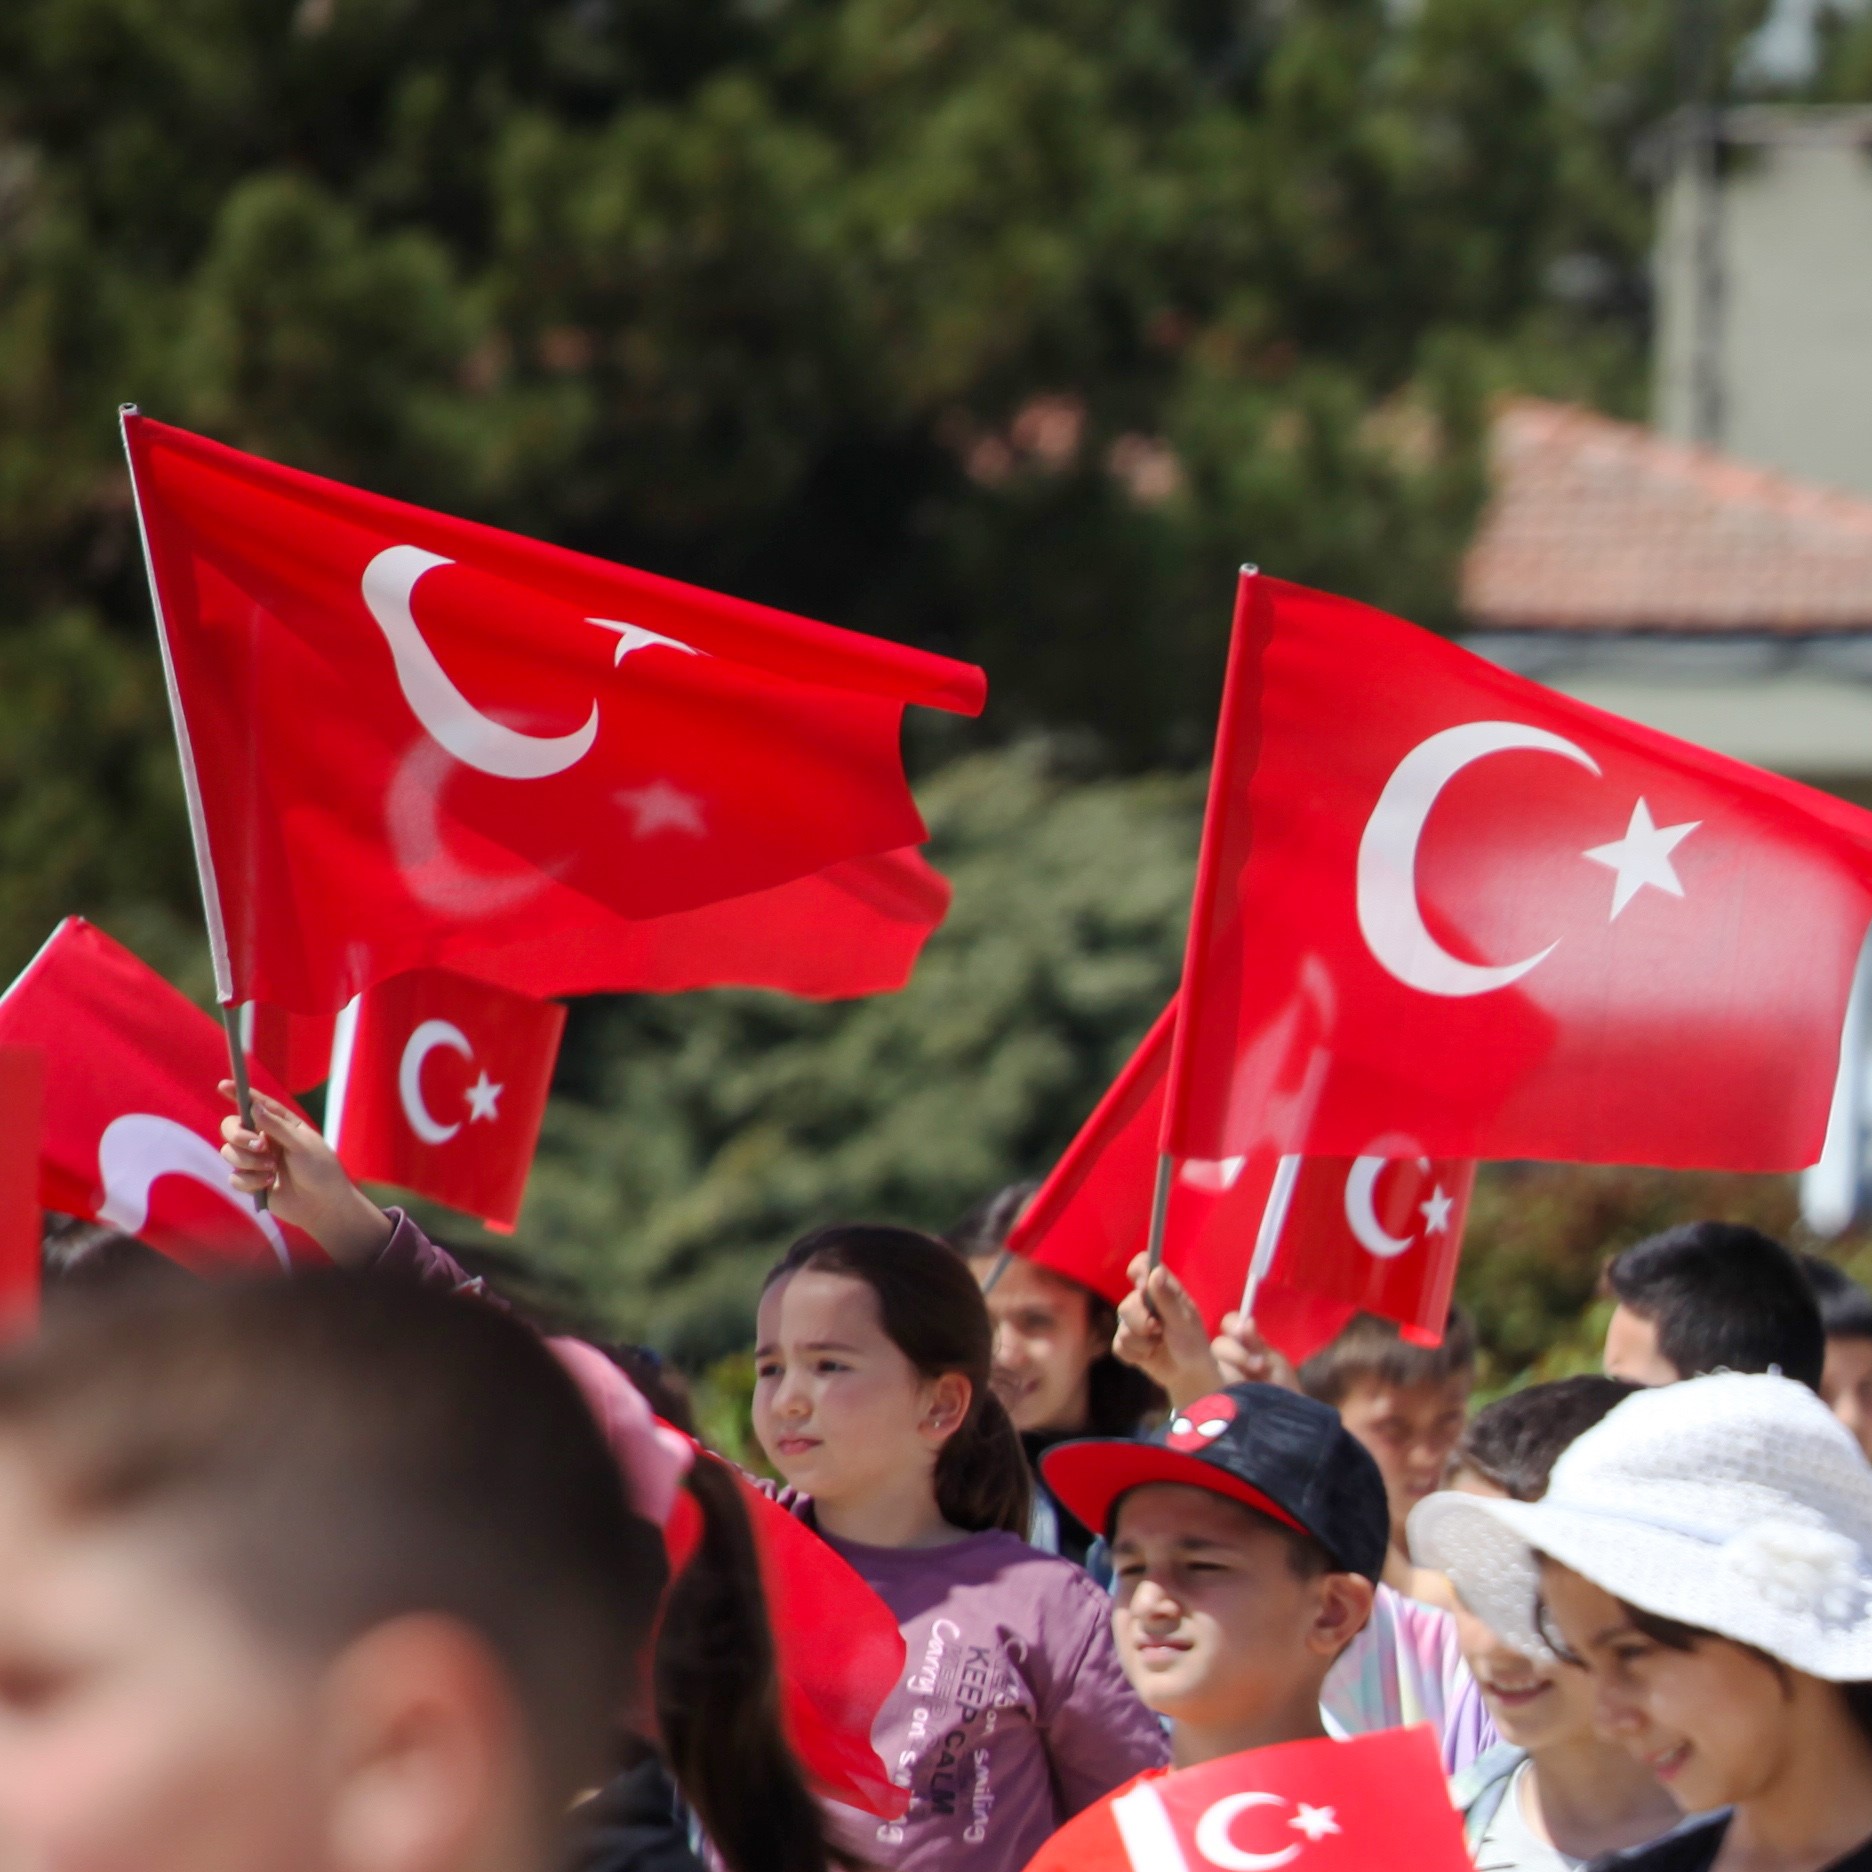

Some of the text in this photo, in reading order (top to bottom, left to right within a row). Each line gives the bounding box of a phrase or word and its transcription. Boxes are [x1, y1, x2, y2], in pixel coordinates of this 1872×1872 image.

[906, 1618, 961, 1697] Carry
[955, 1646, 991, 1724] KEEP
[908, 1707, 929, 1738] on
[931, 1731, 966, 1816] CALM
